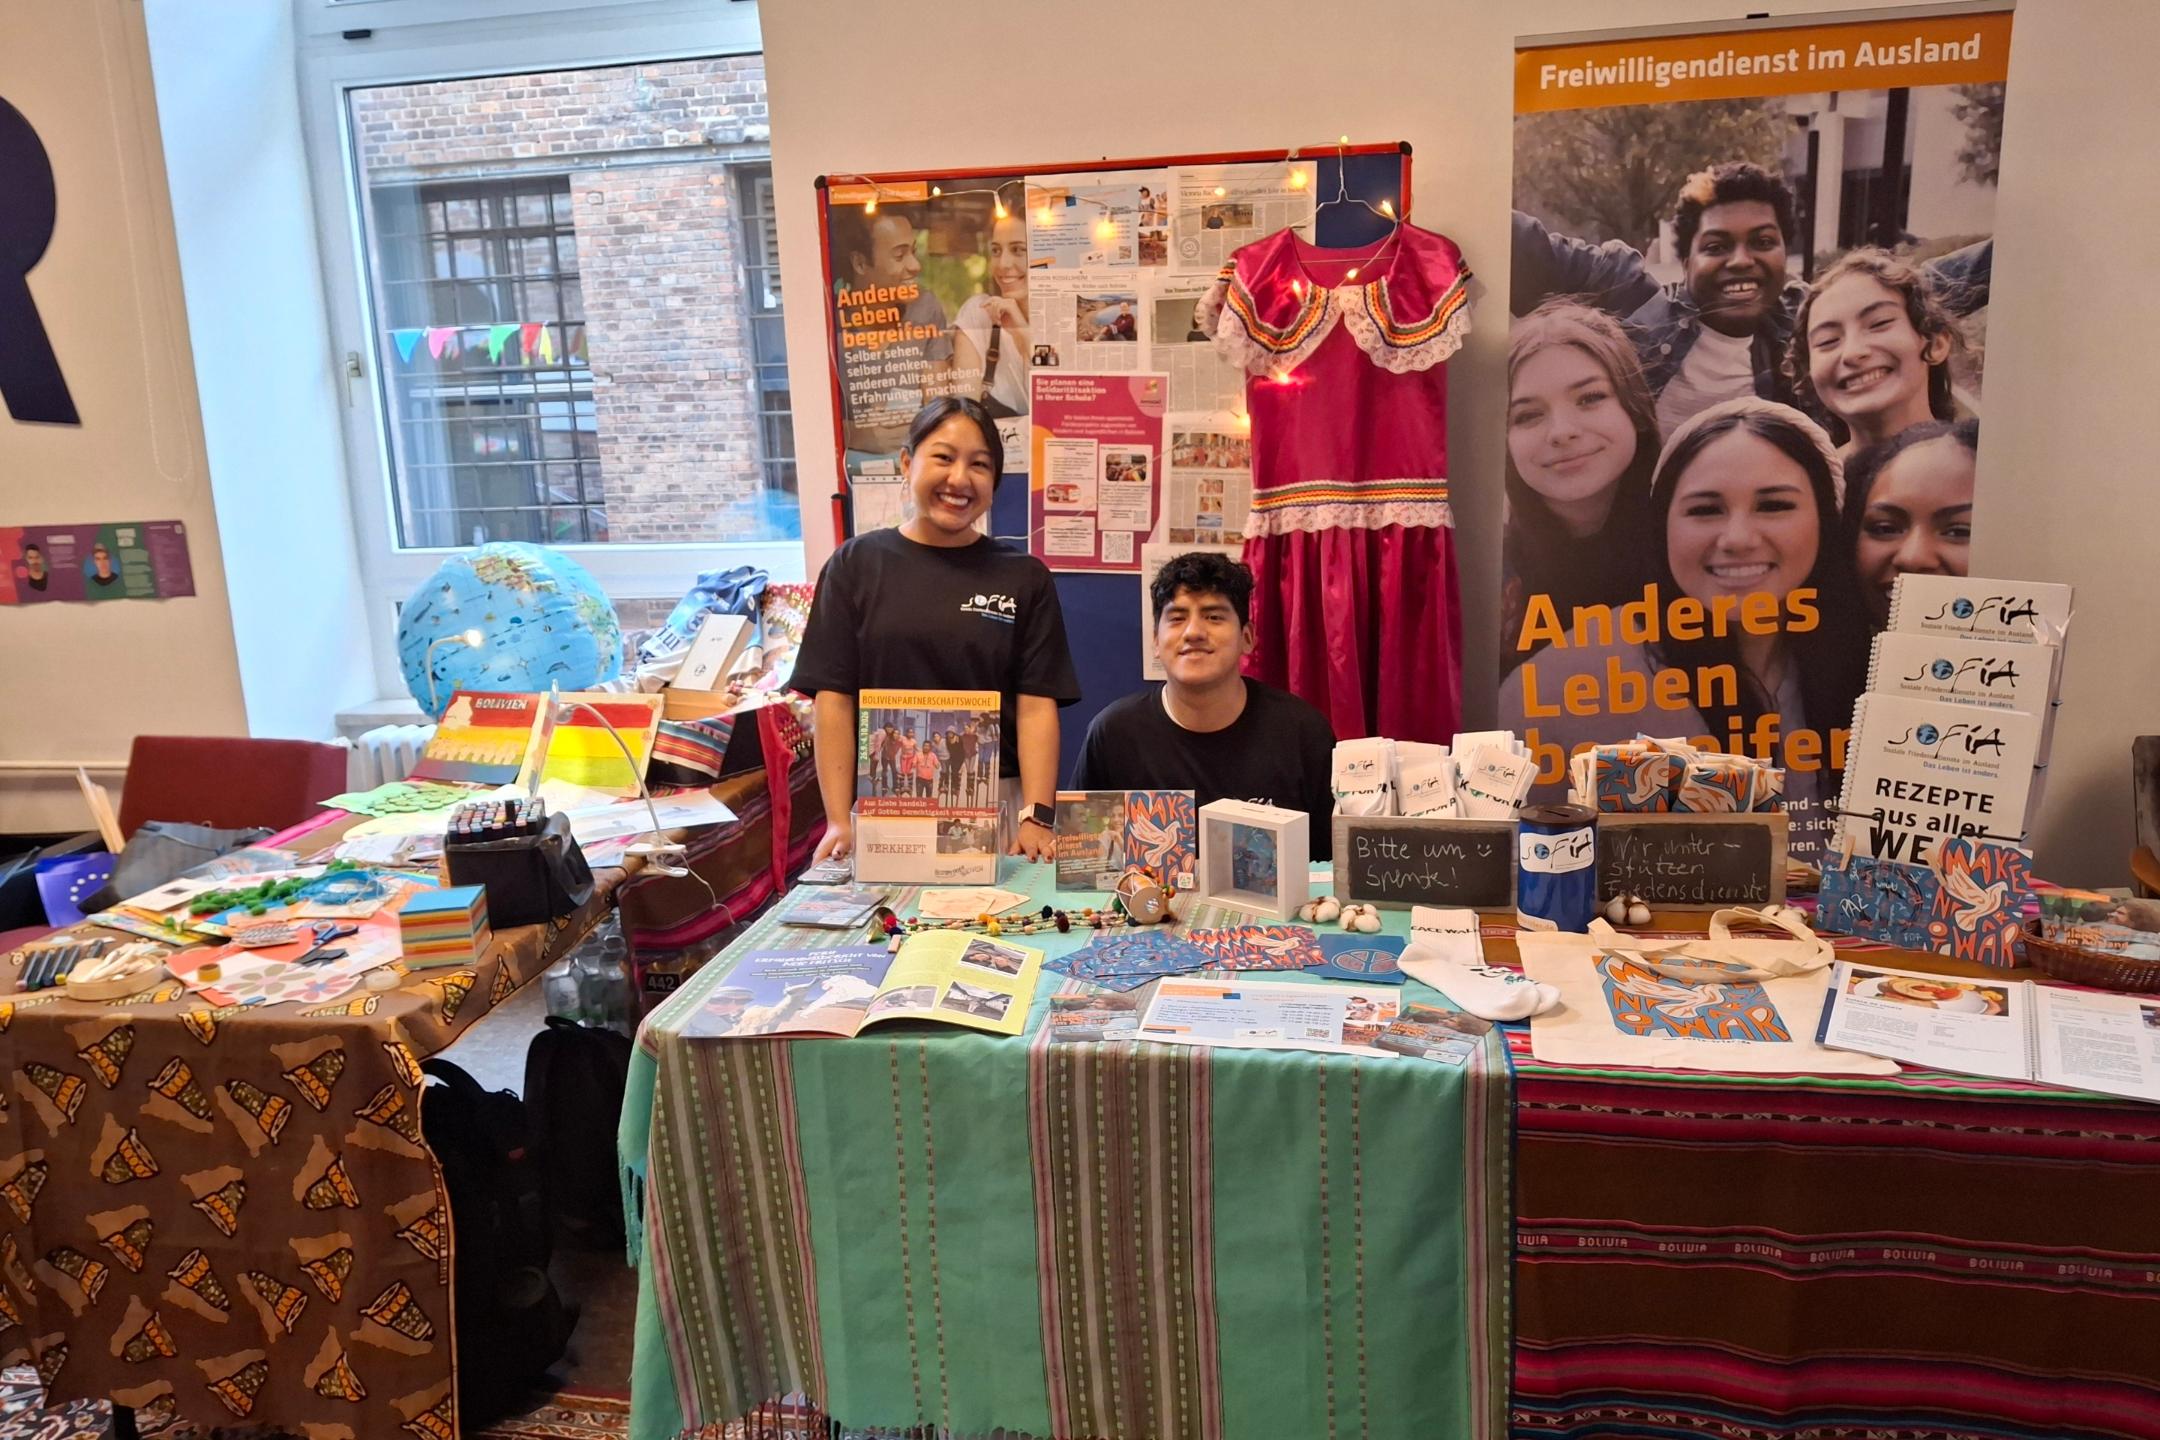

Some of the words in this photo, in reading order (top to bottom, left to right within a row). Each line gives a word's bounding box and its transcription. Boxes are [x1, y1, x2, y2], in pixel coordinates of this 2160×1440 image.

[1539, 49, 1800, 90] Freiwilligendienst
[1807, 43, 1848, 71] im
[1853, 33, 1982, 68] Ausland
[837, 284, 920, 308] Anderes
[839, 307, 900, 328] Leben
[842, 323, 944, 350] begreifen.
[845, 351, 882, 364] Selber
[884, 346, 923, 361] sehen,
[847, 365, 881, 378] selber
[884, 359, 932, 375] denken,
[850, 378, 896, 391] anderen
[899, 373, 934, 386] Alltag
[936, 366, 984, 381] erleben,
[851, 389, 923, 406] Erfahrungen
[926, 383, 975, 397] machen.
[1516, 582, 1820, 651] Anderes
[1521, 658, 1738, 719] Leben
[475, 698, 528, 710] BOLIVIEN
[862, 695, 992, 707] BOLIVIENPARTNERSCHAFTSWOCHE
[1779, 797, 1809, 811] and
[1824, 796, 1838, 809] ei
[1875, 777, 1995, 814] REZEPTE
[1806, 817, 1836, 831] sich
[1872, 806, 1917, 828] aus
[1926, 812, 1989, 838] aller
[866, 843, 926, 854] WERKHEFT
[1357, 836, 1410, 860] Bitte
[1423, 843, 1466, 859] um
[1611, 836, 1653, 858] Wir
[1787, 841, 1820, 852] ren.
[1869, 826, 1934, 866] WE
[1945, 845, 2026, 894] MAKE
[1411, 926, 1442, 934] EACE
[1952, 922, 2019, 968] WAR
[648, 976, 675, 990] 442
